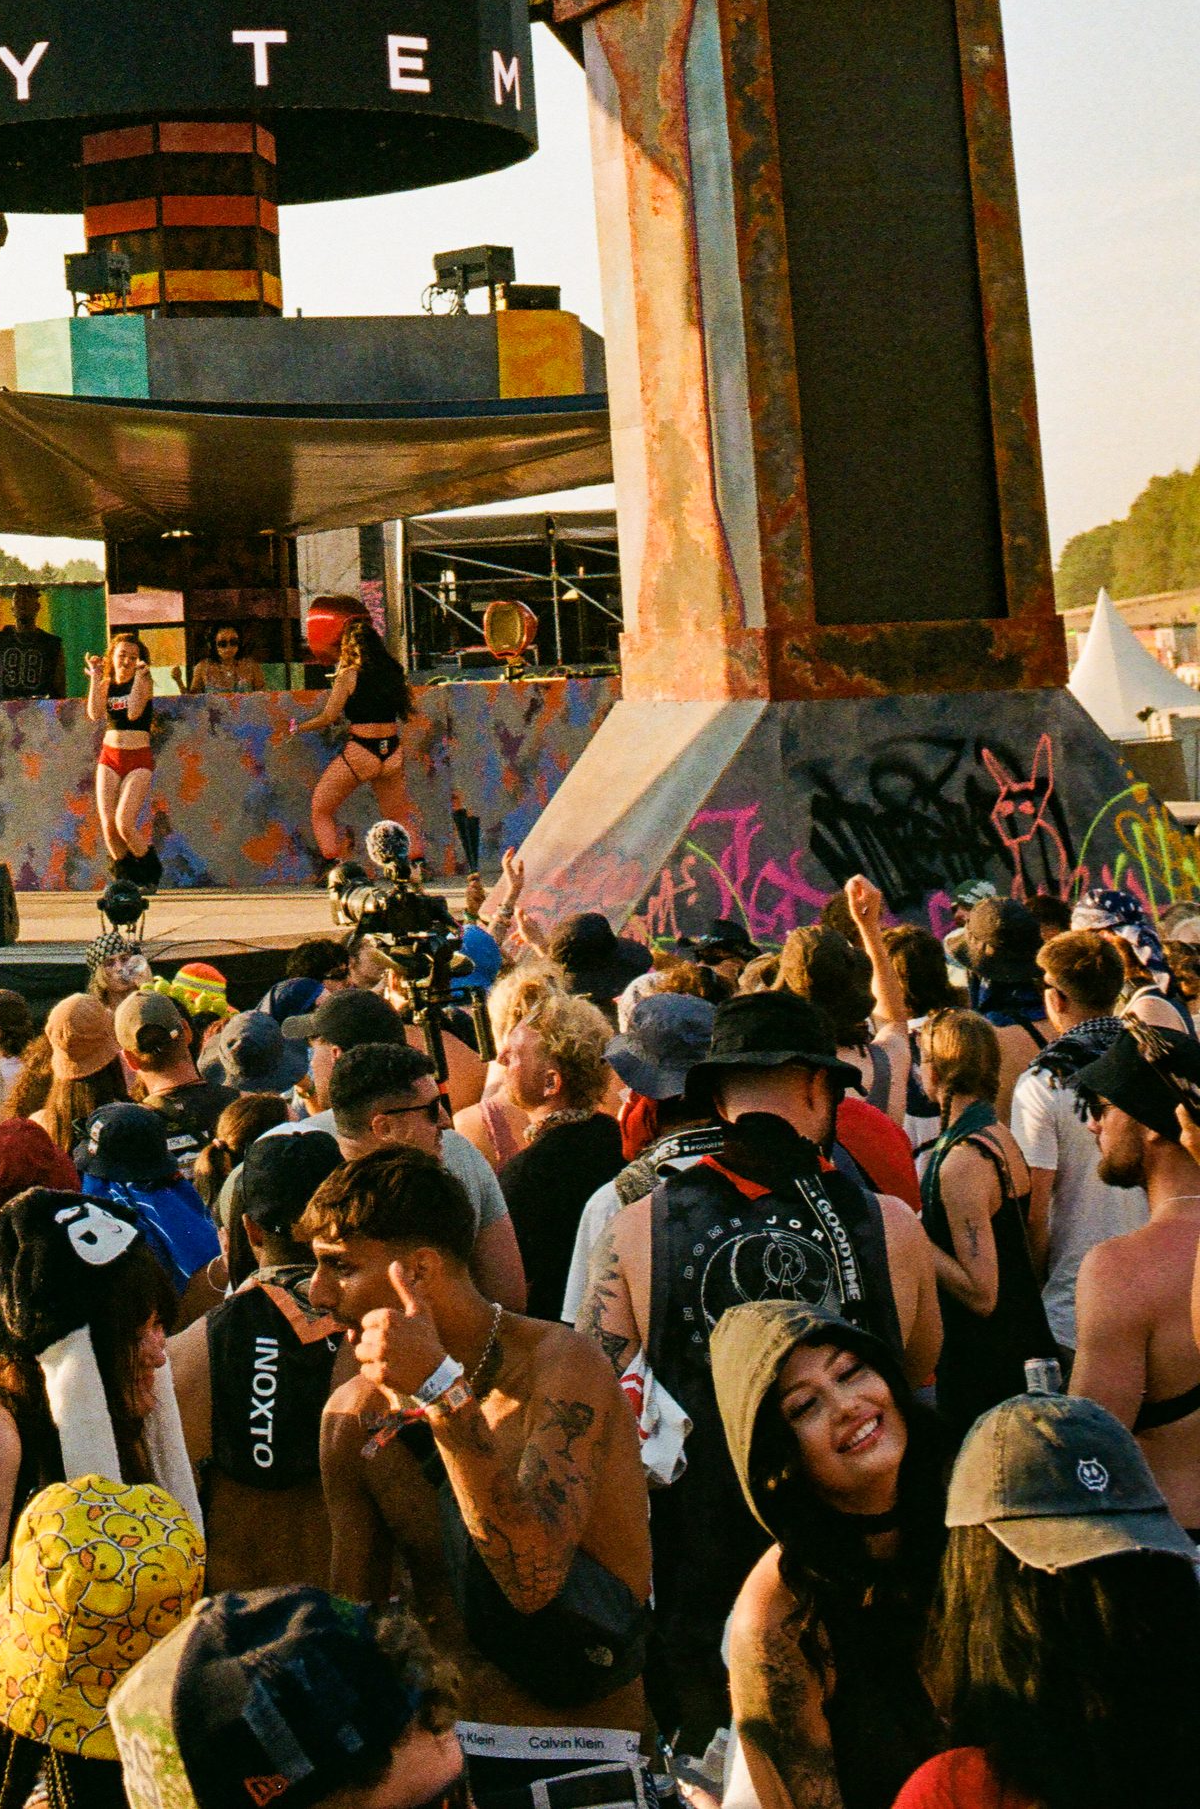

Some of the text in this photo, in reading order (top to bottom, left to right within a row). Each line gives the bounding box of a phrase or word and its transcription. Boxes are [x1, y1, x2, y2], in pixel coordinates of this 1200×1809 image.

[250, 1336, 279, 1468] INOXTO
[467, 1732, 496, 1747] Klein
[528, 1736, 605, 1750] Calvin Klein
